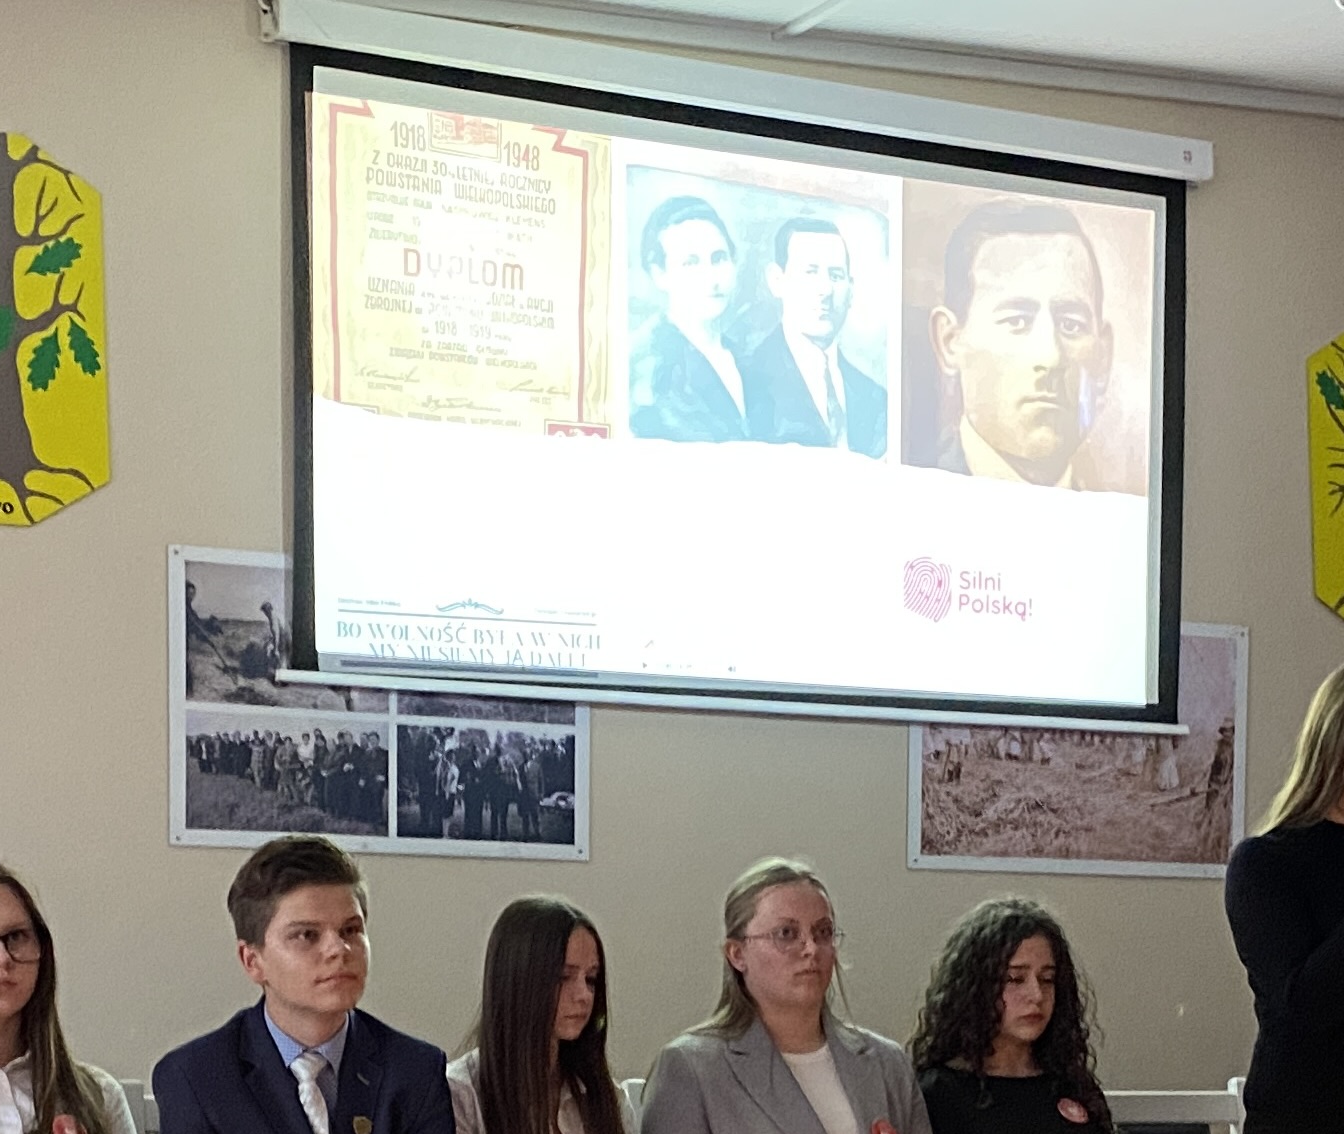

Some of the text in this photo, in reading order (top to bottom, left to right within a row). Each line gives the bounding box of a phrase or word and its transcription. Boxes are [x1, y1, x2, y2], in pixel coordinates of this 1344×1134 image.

[390, 121, 427, 151] 1918
[503, 140, 540, 171] 1948
[371, 150, 380, 165] Z
[500, 171, 551, 194] ROCZNICY
[366, 167, 442, 195] POWSTANIA
[454, 183, 556, 215] WIELKOPOLSKIEGO
[403, 247, 524, 291] DYPLOM
[959, 571, 1001, 591] Silni
[958, 594, 1032, 622] Polską!
[336, 621, 362, 640] BO
